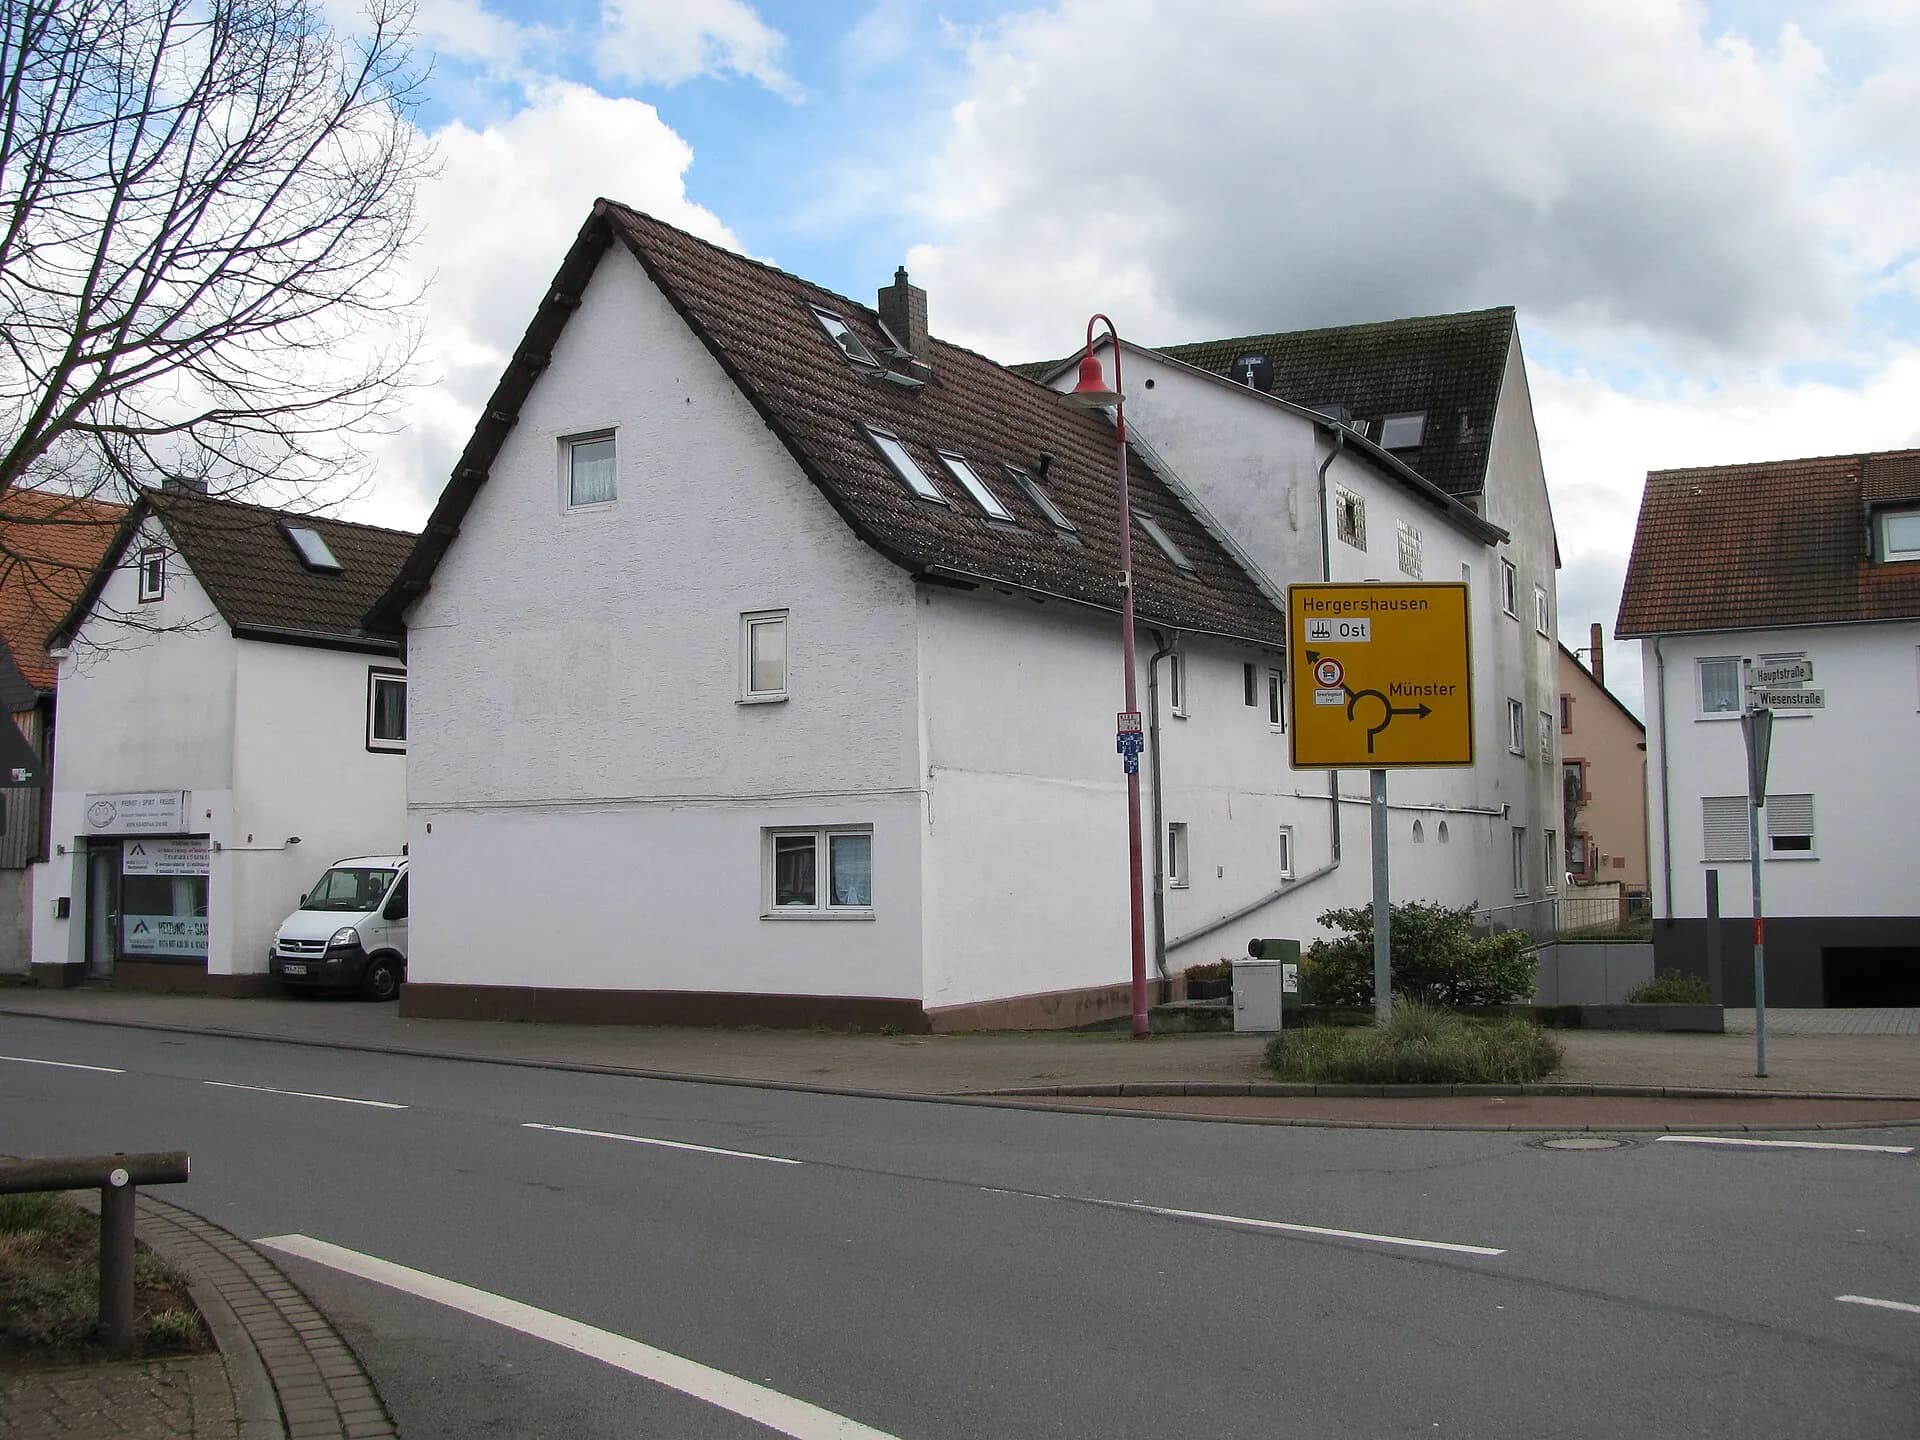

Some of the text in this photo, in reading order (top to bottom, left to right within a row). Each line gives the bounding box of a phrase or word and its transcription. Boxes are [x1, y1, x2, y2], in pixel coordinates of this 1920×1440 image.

[1303, 597, 1428, 614] Hergershausen
[1339, 623, 1366, 637] Ost
[1757, 665, 1805, 682] Hauptstraße
[1389, 682, 1456, 697] Münster
[1760, 692, 1821, 705] Wiesenstraße
